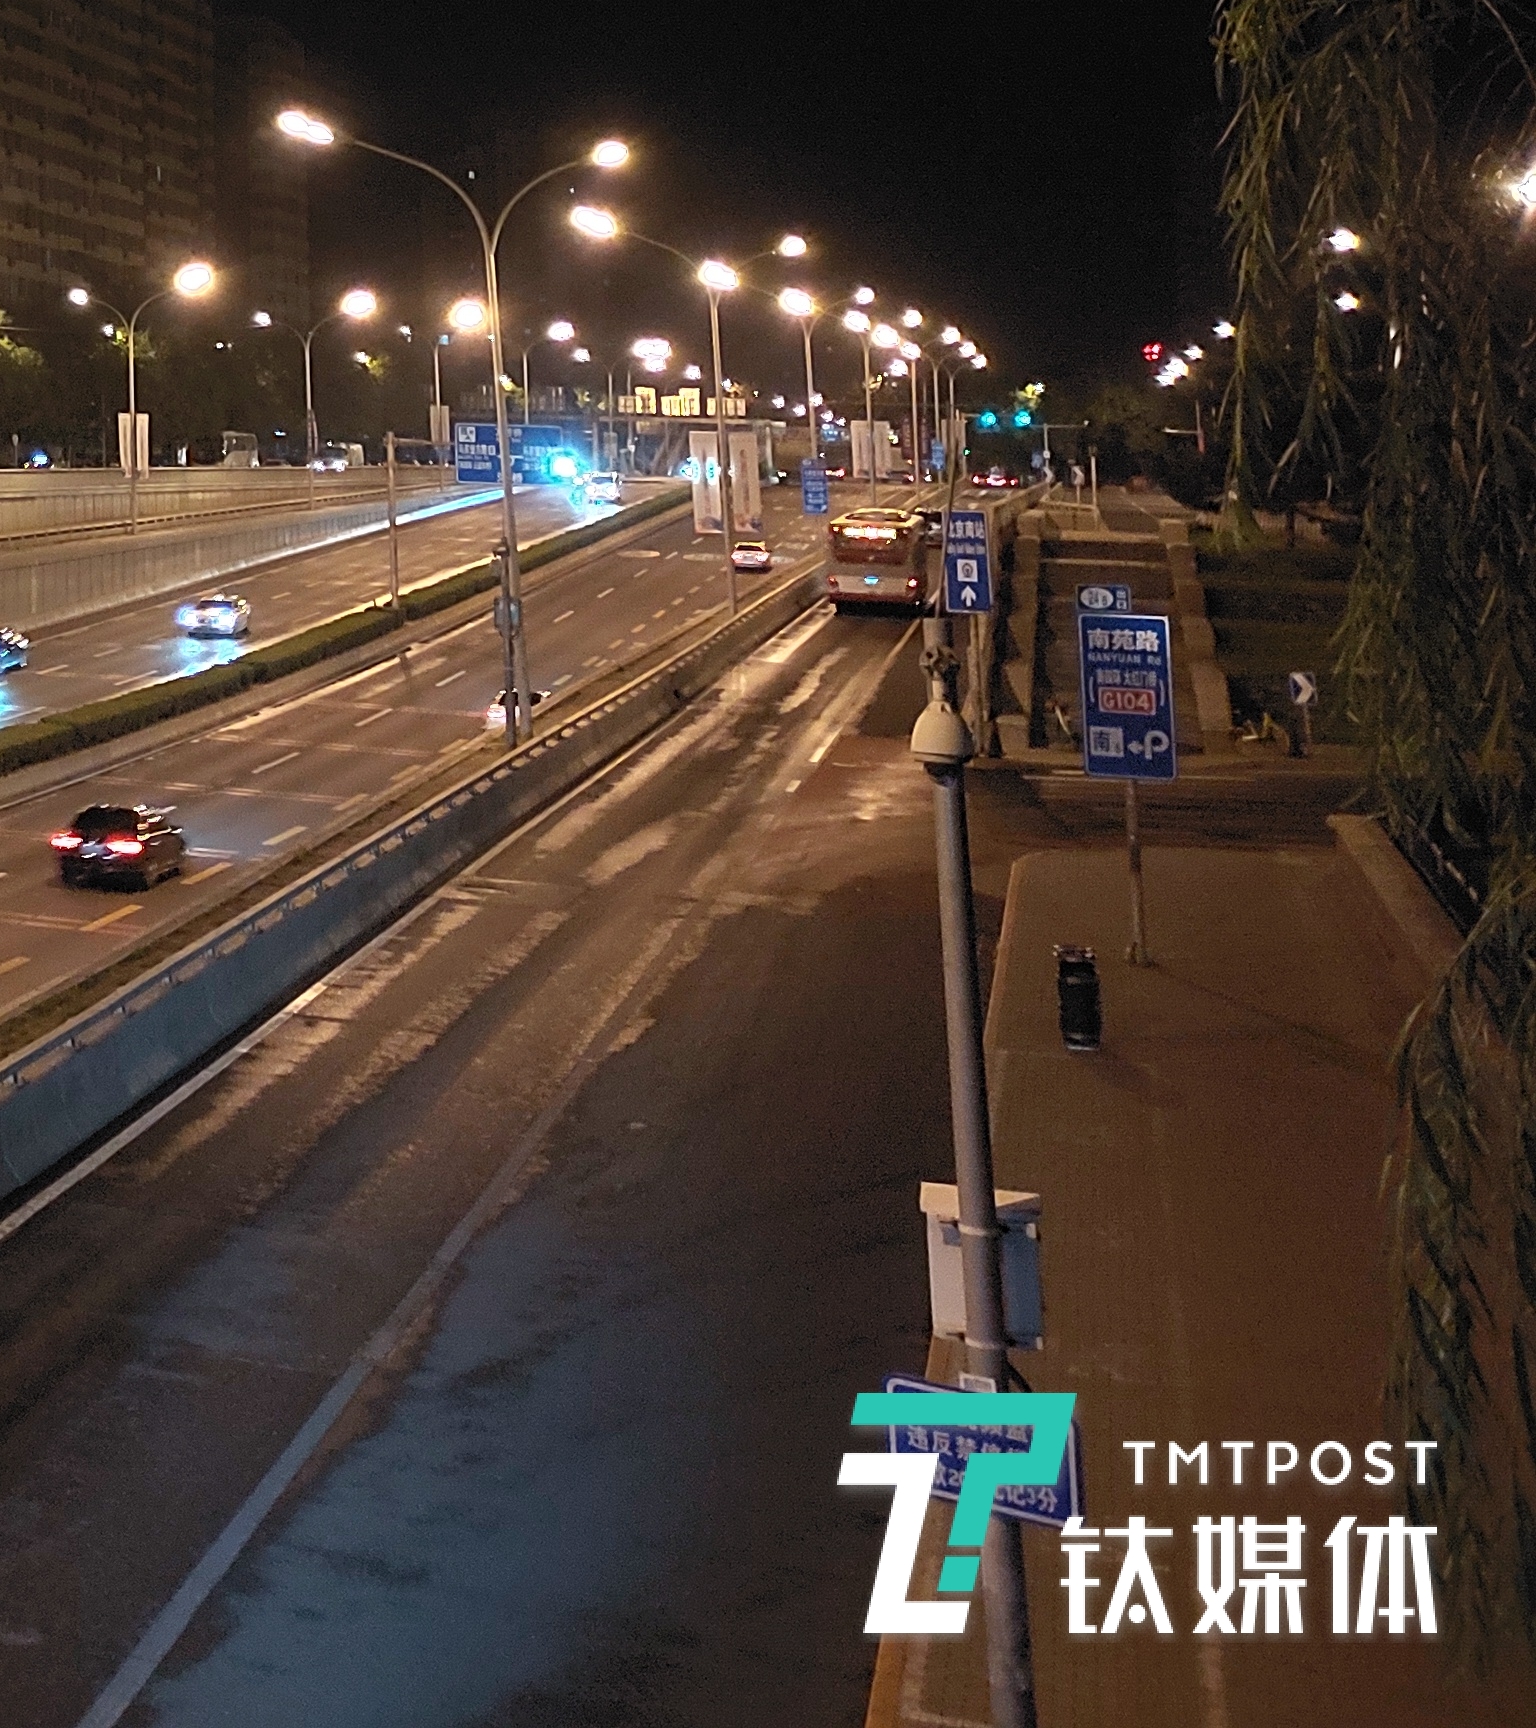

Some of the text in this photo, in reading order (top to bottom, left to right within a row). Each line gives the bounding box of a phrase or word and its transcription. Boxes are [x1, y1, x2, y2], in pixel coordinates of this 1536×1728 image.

[1088, 628, 1160, 652] 南苑路
[1088, 652, 1141, 663] NANYUAN
[1103, 692, 1149, 710] G104
